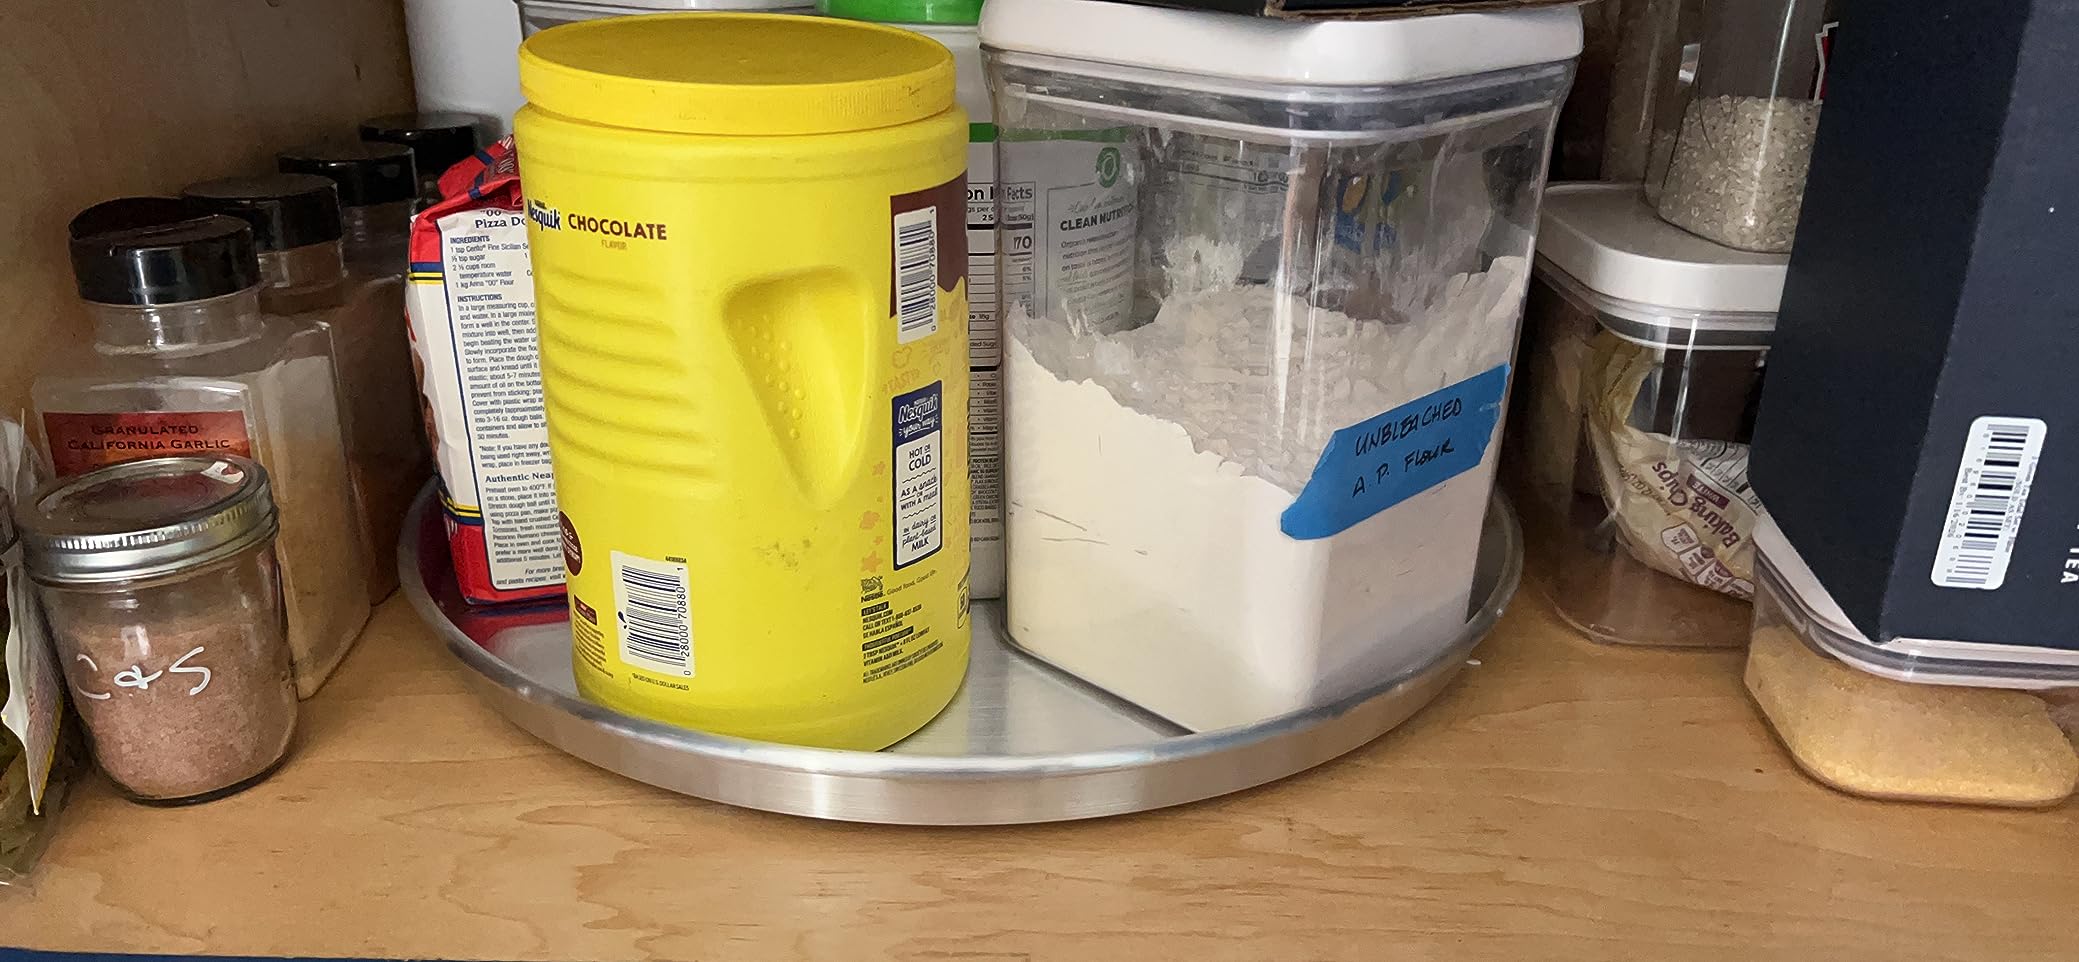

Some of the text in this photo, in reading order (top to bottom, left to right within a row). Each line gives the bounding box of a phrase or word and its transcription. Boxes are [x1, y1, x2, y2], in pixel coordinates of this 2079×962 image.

[475, 219, 507, 228] Pizza
[568, 214, 667, 240] CHOCOLATE
[1060, 215, 1097, 230] CLEAN
[450, 236, 490, 244] INGREDIENTS
[460, 272, 494, 280] temperature
[457, 294, 502, 302] INSTRUCTIONS
[898, 394, 938, 424] Nesquik
[91, 426, 198, 435] GRANULATED
[1356, 398, 1462, 456] UNBLEACHED
[68, 440, 230, 450] CALIFORNIA GARLIC
[909, 447, 922, 458] HOT
[1404, 438, 1454, 472] FLOUR
[909, 454, 931, 471] COLD
[486, 474, 529, 482] Authentic
[1652, 462, 1688, 506] Chips
[901, 488, 910, 497] AS
[901, 500, 916, 511] WITH
[912, 519, 928, 530] dairy
[1690, 497, 1741, 548] Baking
[911, 537, 928, 552] MILK
[676, 587, 687, 619] 70880
[863, 622, 874, 631] CALL
[679, 624, 690, 657] 28000
